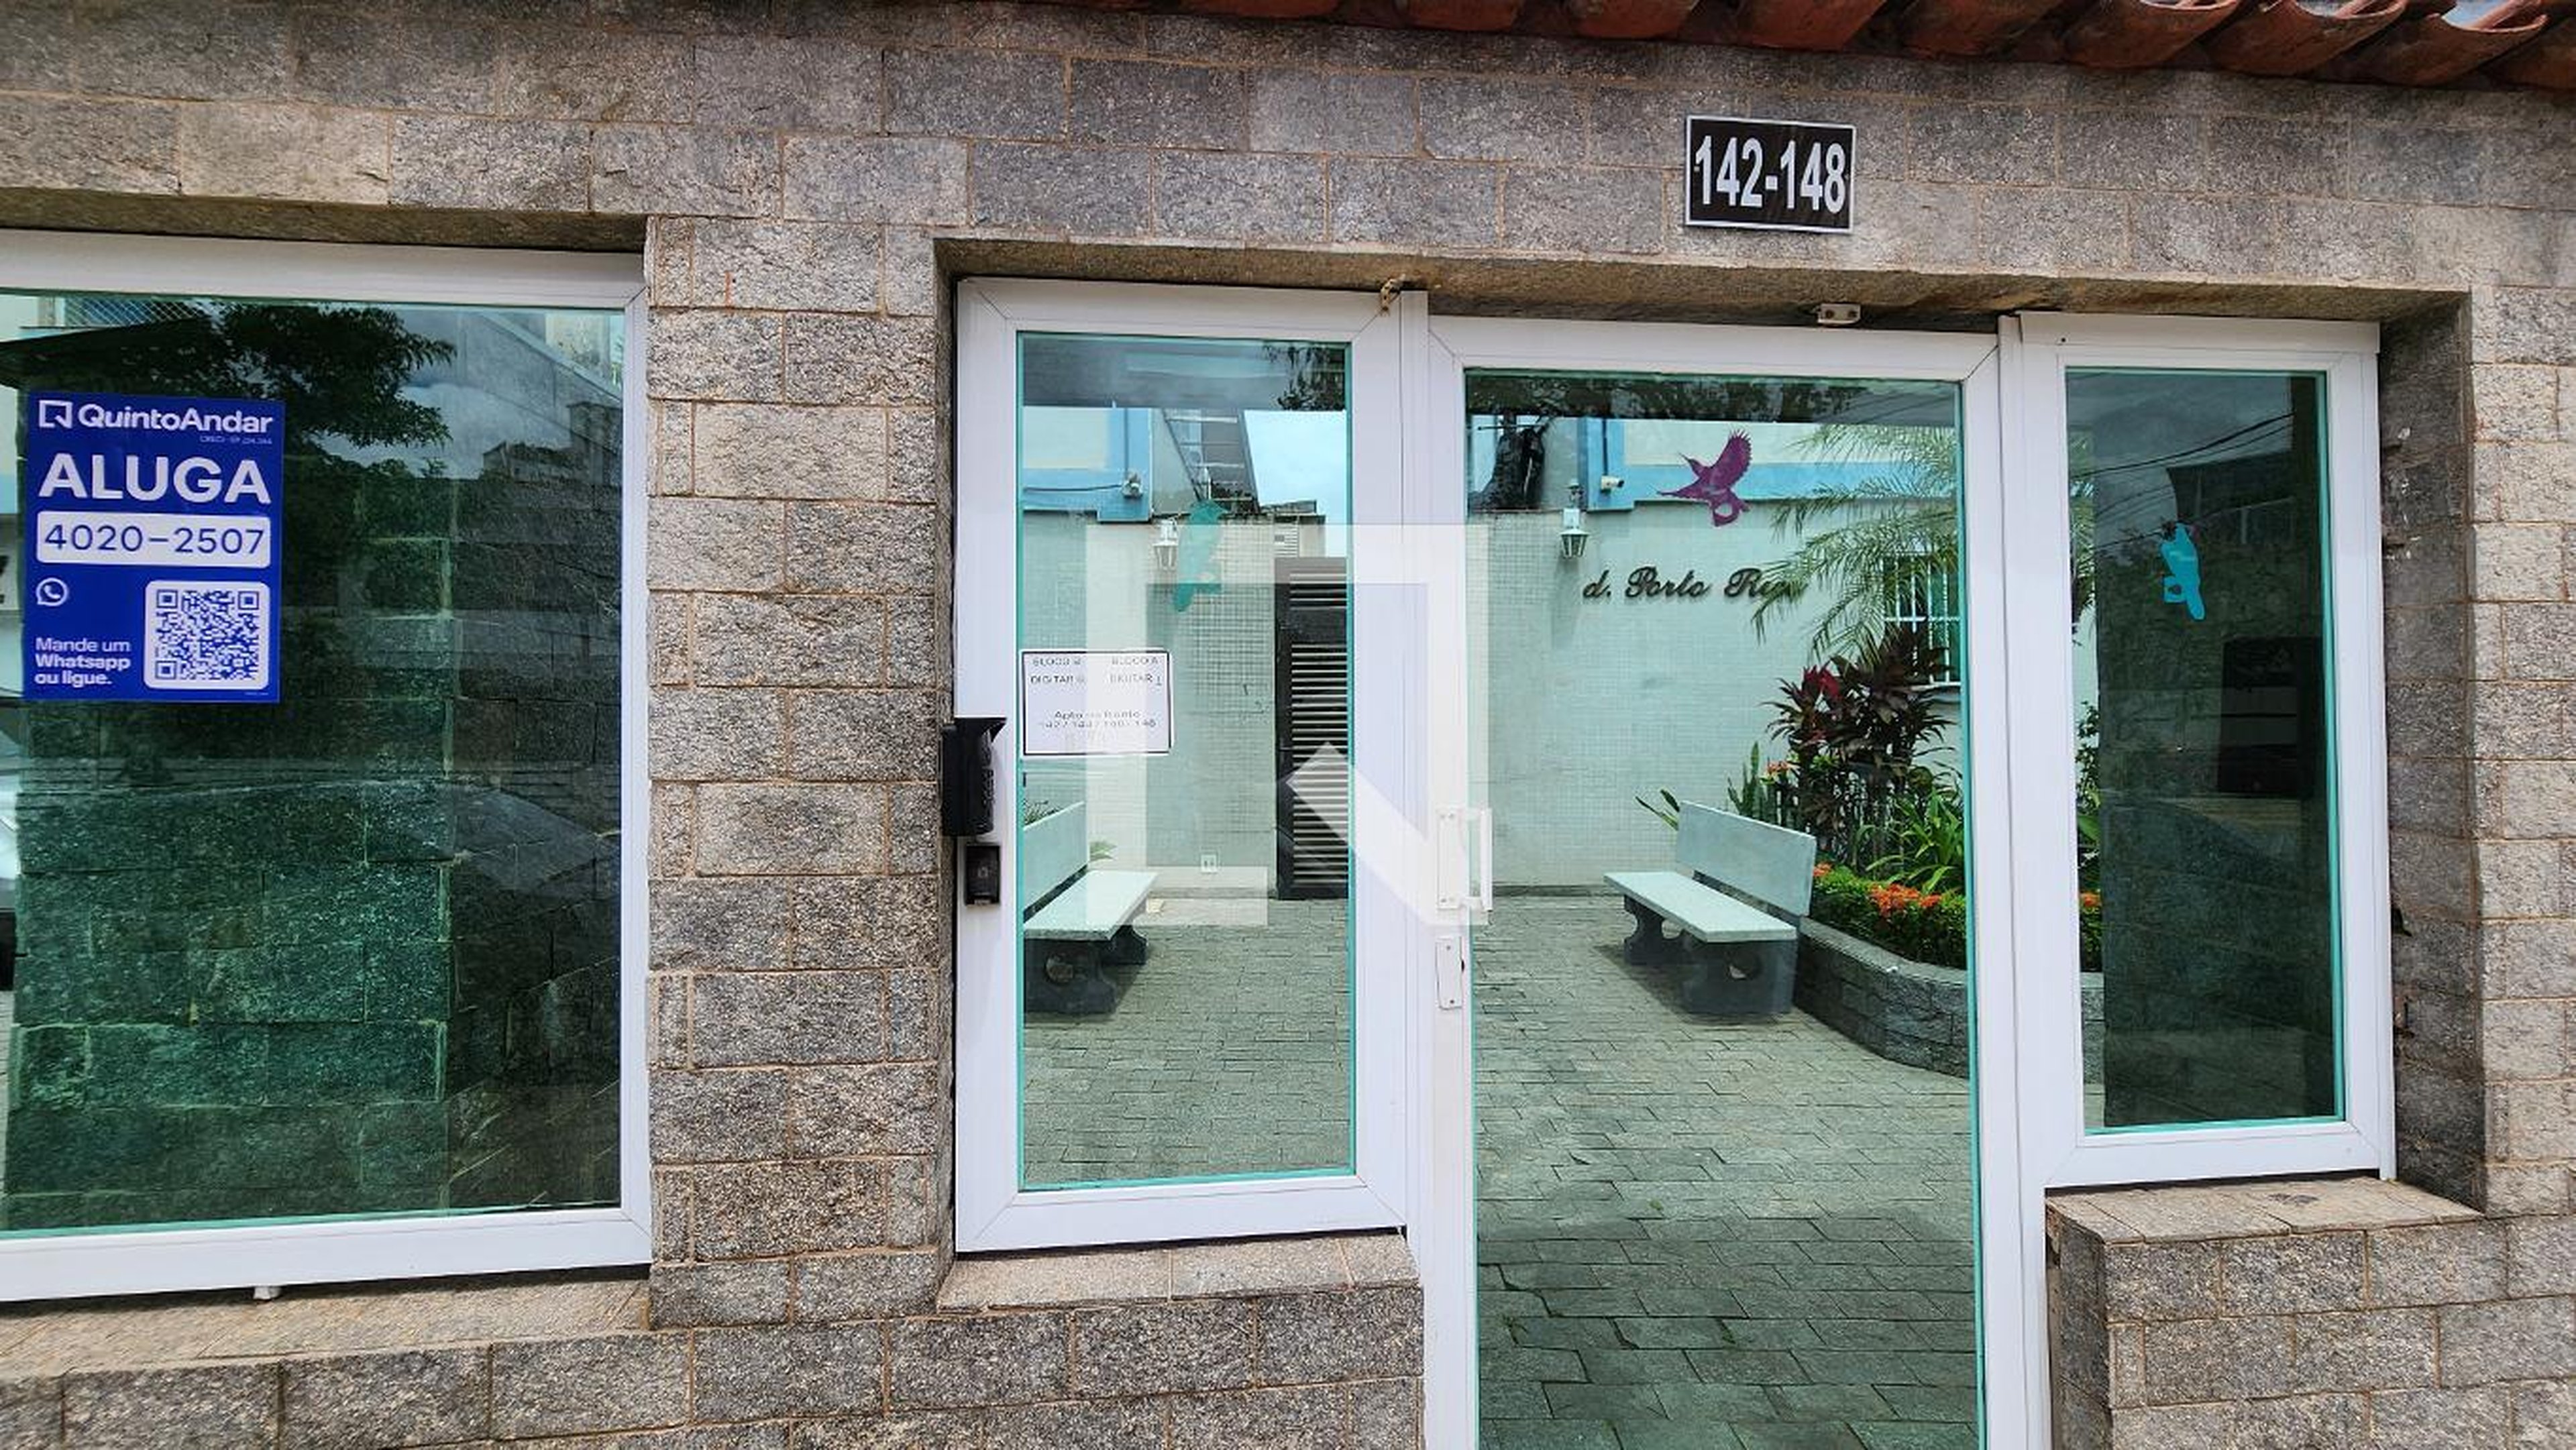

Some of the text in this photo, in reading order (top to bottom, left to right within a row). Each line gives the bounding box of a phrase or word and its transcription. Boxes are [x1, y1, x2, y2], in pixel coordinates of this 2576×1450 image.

[1695, 135, 1845, 214] 142-148
[78, 403, 273, 434] QuintoAndar
[38, 452, 272, 504] ALUGA
[44, 523, 264, 555] 4020-2507
[1625, 565, 1713, 598] Porto
[36, 637, 131, 653] Mande um
[35, 653, 131, 671] Whatsapp
[34, 670, 113, 688] ou ligue.
